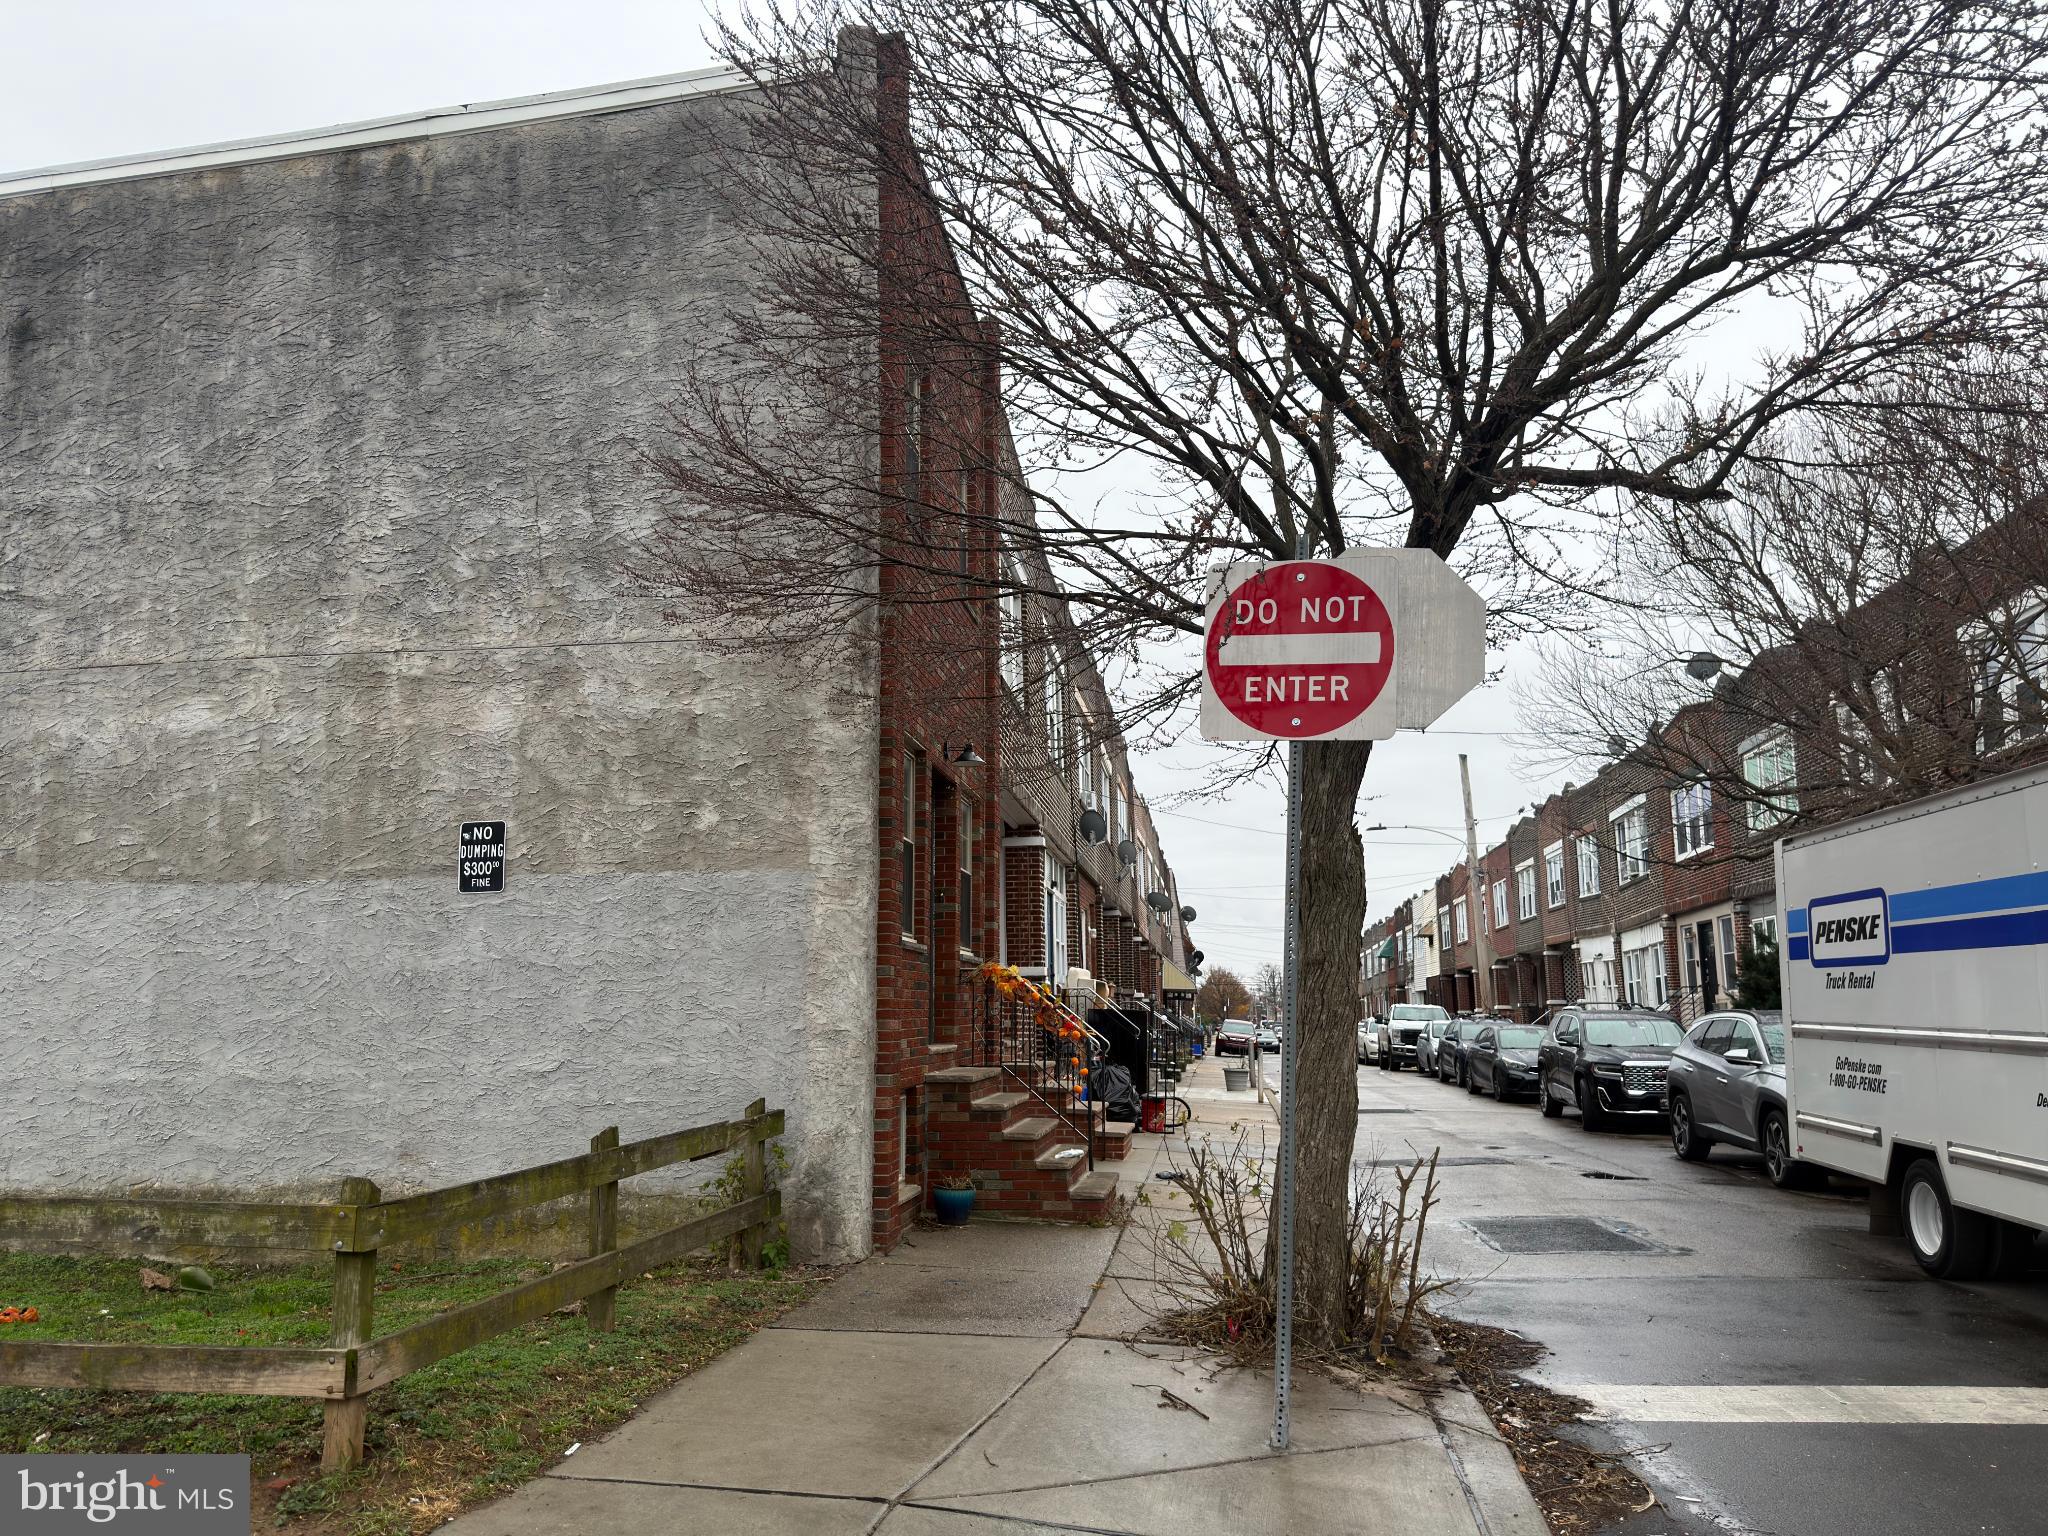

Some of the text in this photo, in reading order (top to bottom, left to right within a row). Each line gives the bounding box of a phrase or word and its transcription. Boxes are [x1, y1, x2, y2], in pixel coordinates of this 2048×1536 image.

[1235, 596, 1365, 625] DO NOT
[1245, 675, 1349, 703] ENTER
[473, 826, 493, 841] NO
[461, 843, 504, 859] DUMPING
[471, 877, 491, 888] FINE
[1815, 914, 1881, 944] PENSKE
[1825, 971, 1876, 989] Truck Rental
[1835, 1055, 1882, 1075] GoPenskecom
[1829, 1072, 1888, 1094] 1-800-GO-PENSKE
